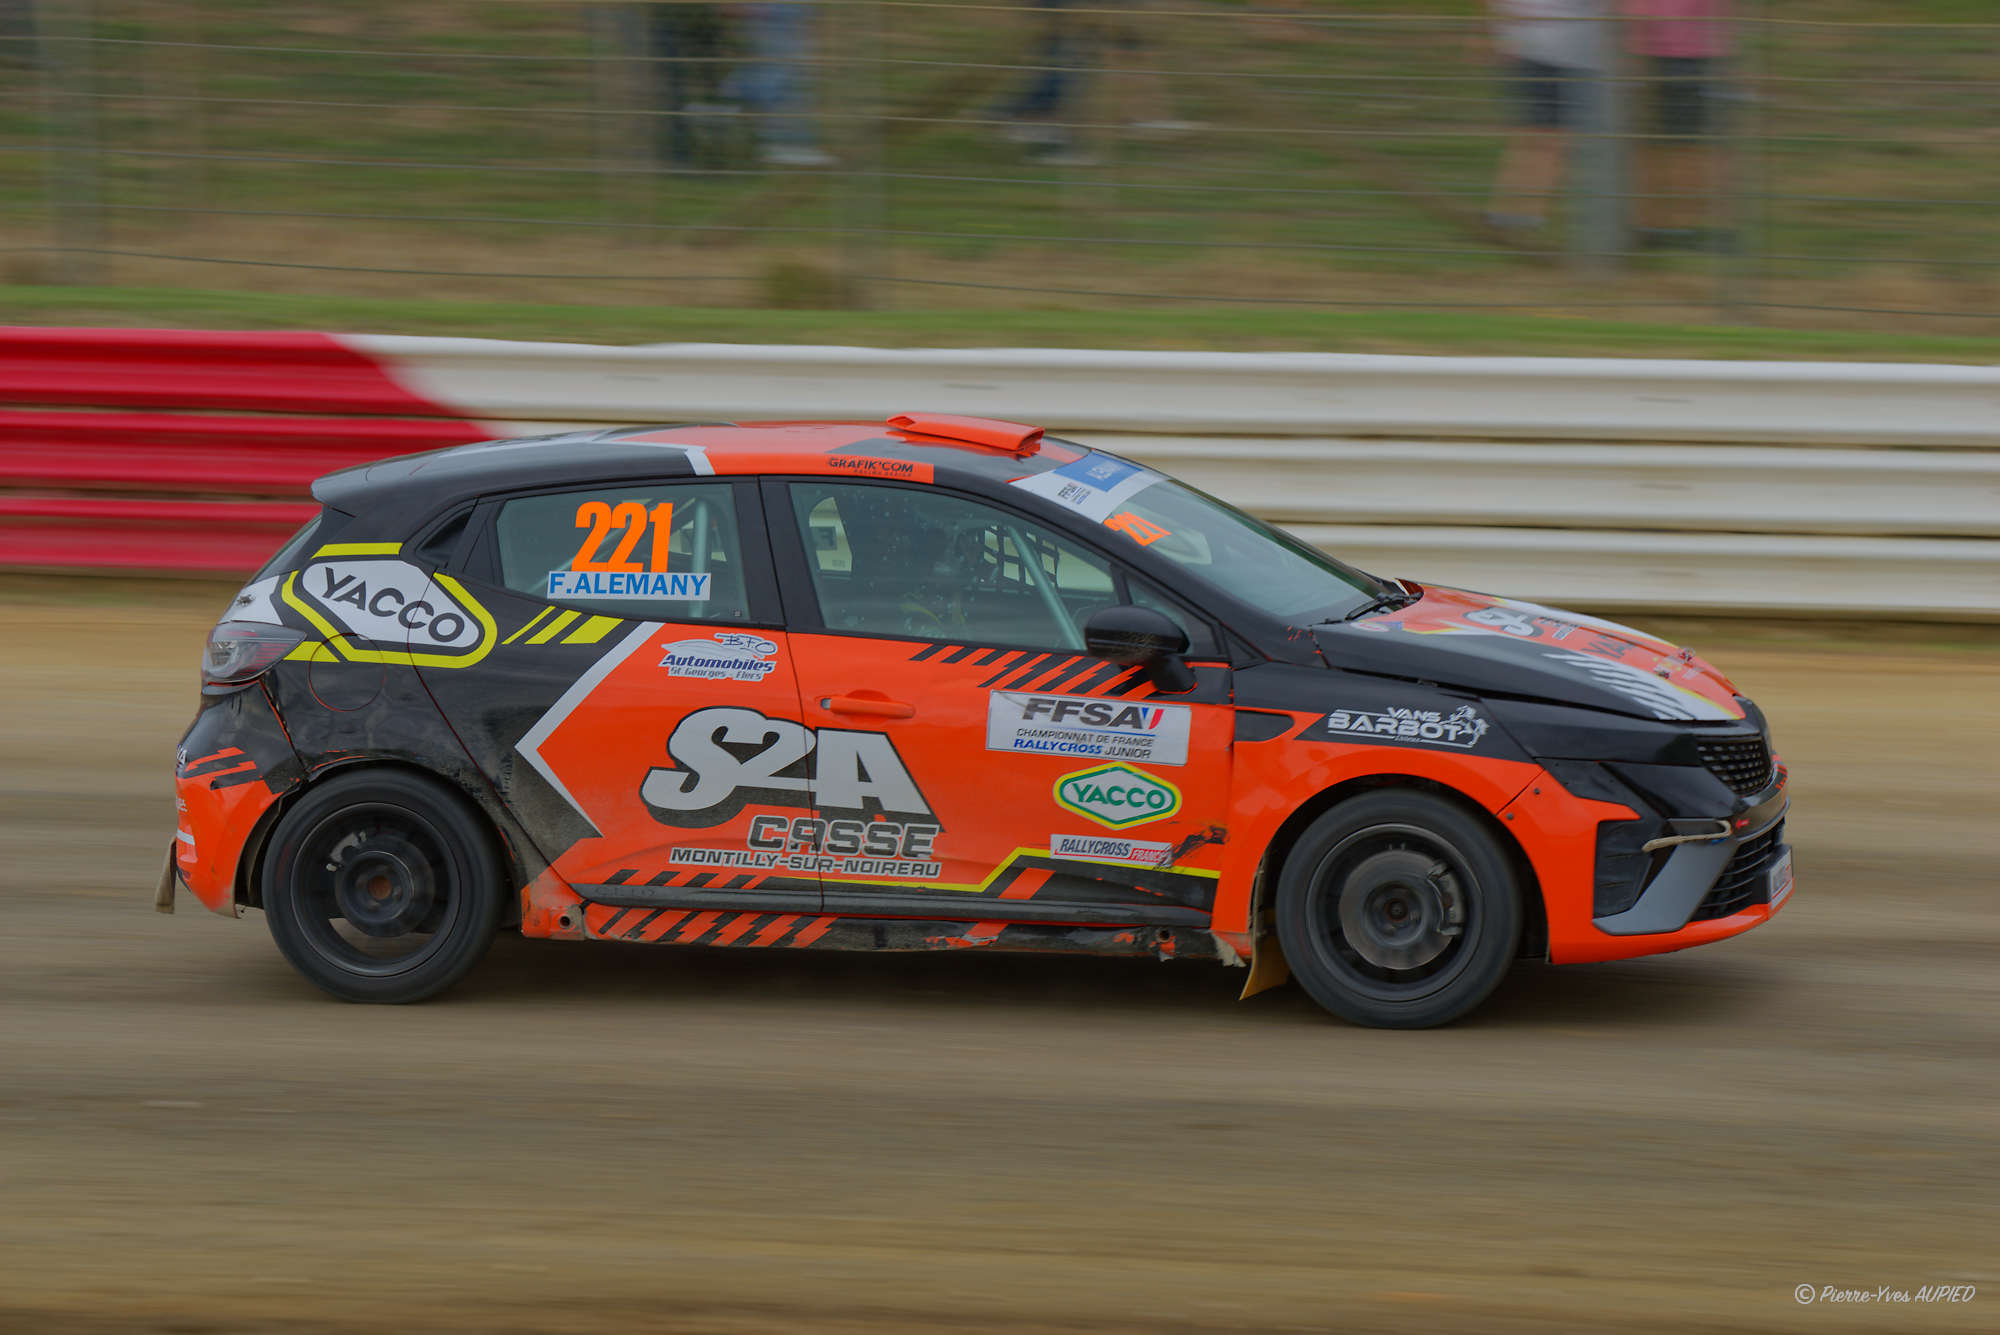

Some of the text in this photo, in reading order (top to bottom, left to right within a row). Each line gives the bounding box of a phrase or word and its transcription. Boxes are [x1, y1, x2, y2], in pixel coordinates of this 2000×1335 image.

[830, 458, 914, 473] GRAFIK'COM
[571, 501, 674, 573] 221
[549, 573, 708, 596] F.ALEMANY
[322, 567, 465, 643] YACCO
[662, 655, 773, 671] Automobiles
[1022, 698, 1143, 730] FFSA
[1327, 712, 1463, 742] BARBOT
[1386, 706, 1442, 723] VANS
[1013, 738, 1152, 759] RALLYCROSS JUNIOR
[1016, 728, 1154, 748] CHAMPIONNAT DE FRANCE
[639, 706, 940, 824] S2A
[1072, 783, 1166, 809] YACCO
[747, 814, 940, 861] CASSE
[1060, 838, 1131, 857] RALLYCROSS
[669, 848, 943, 878] MONTILLY-SUR-NOIREAU
